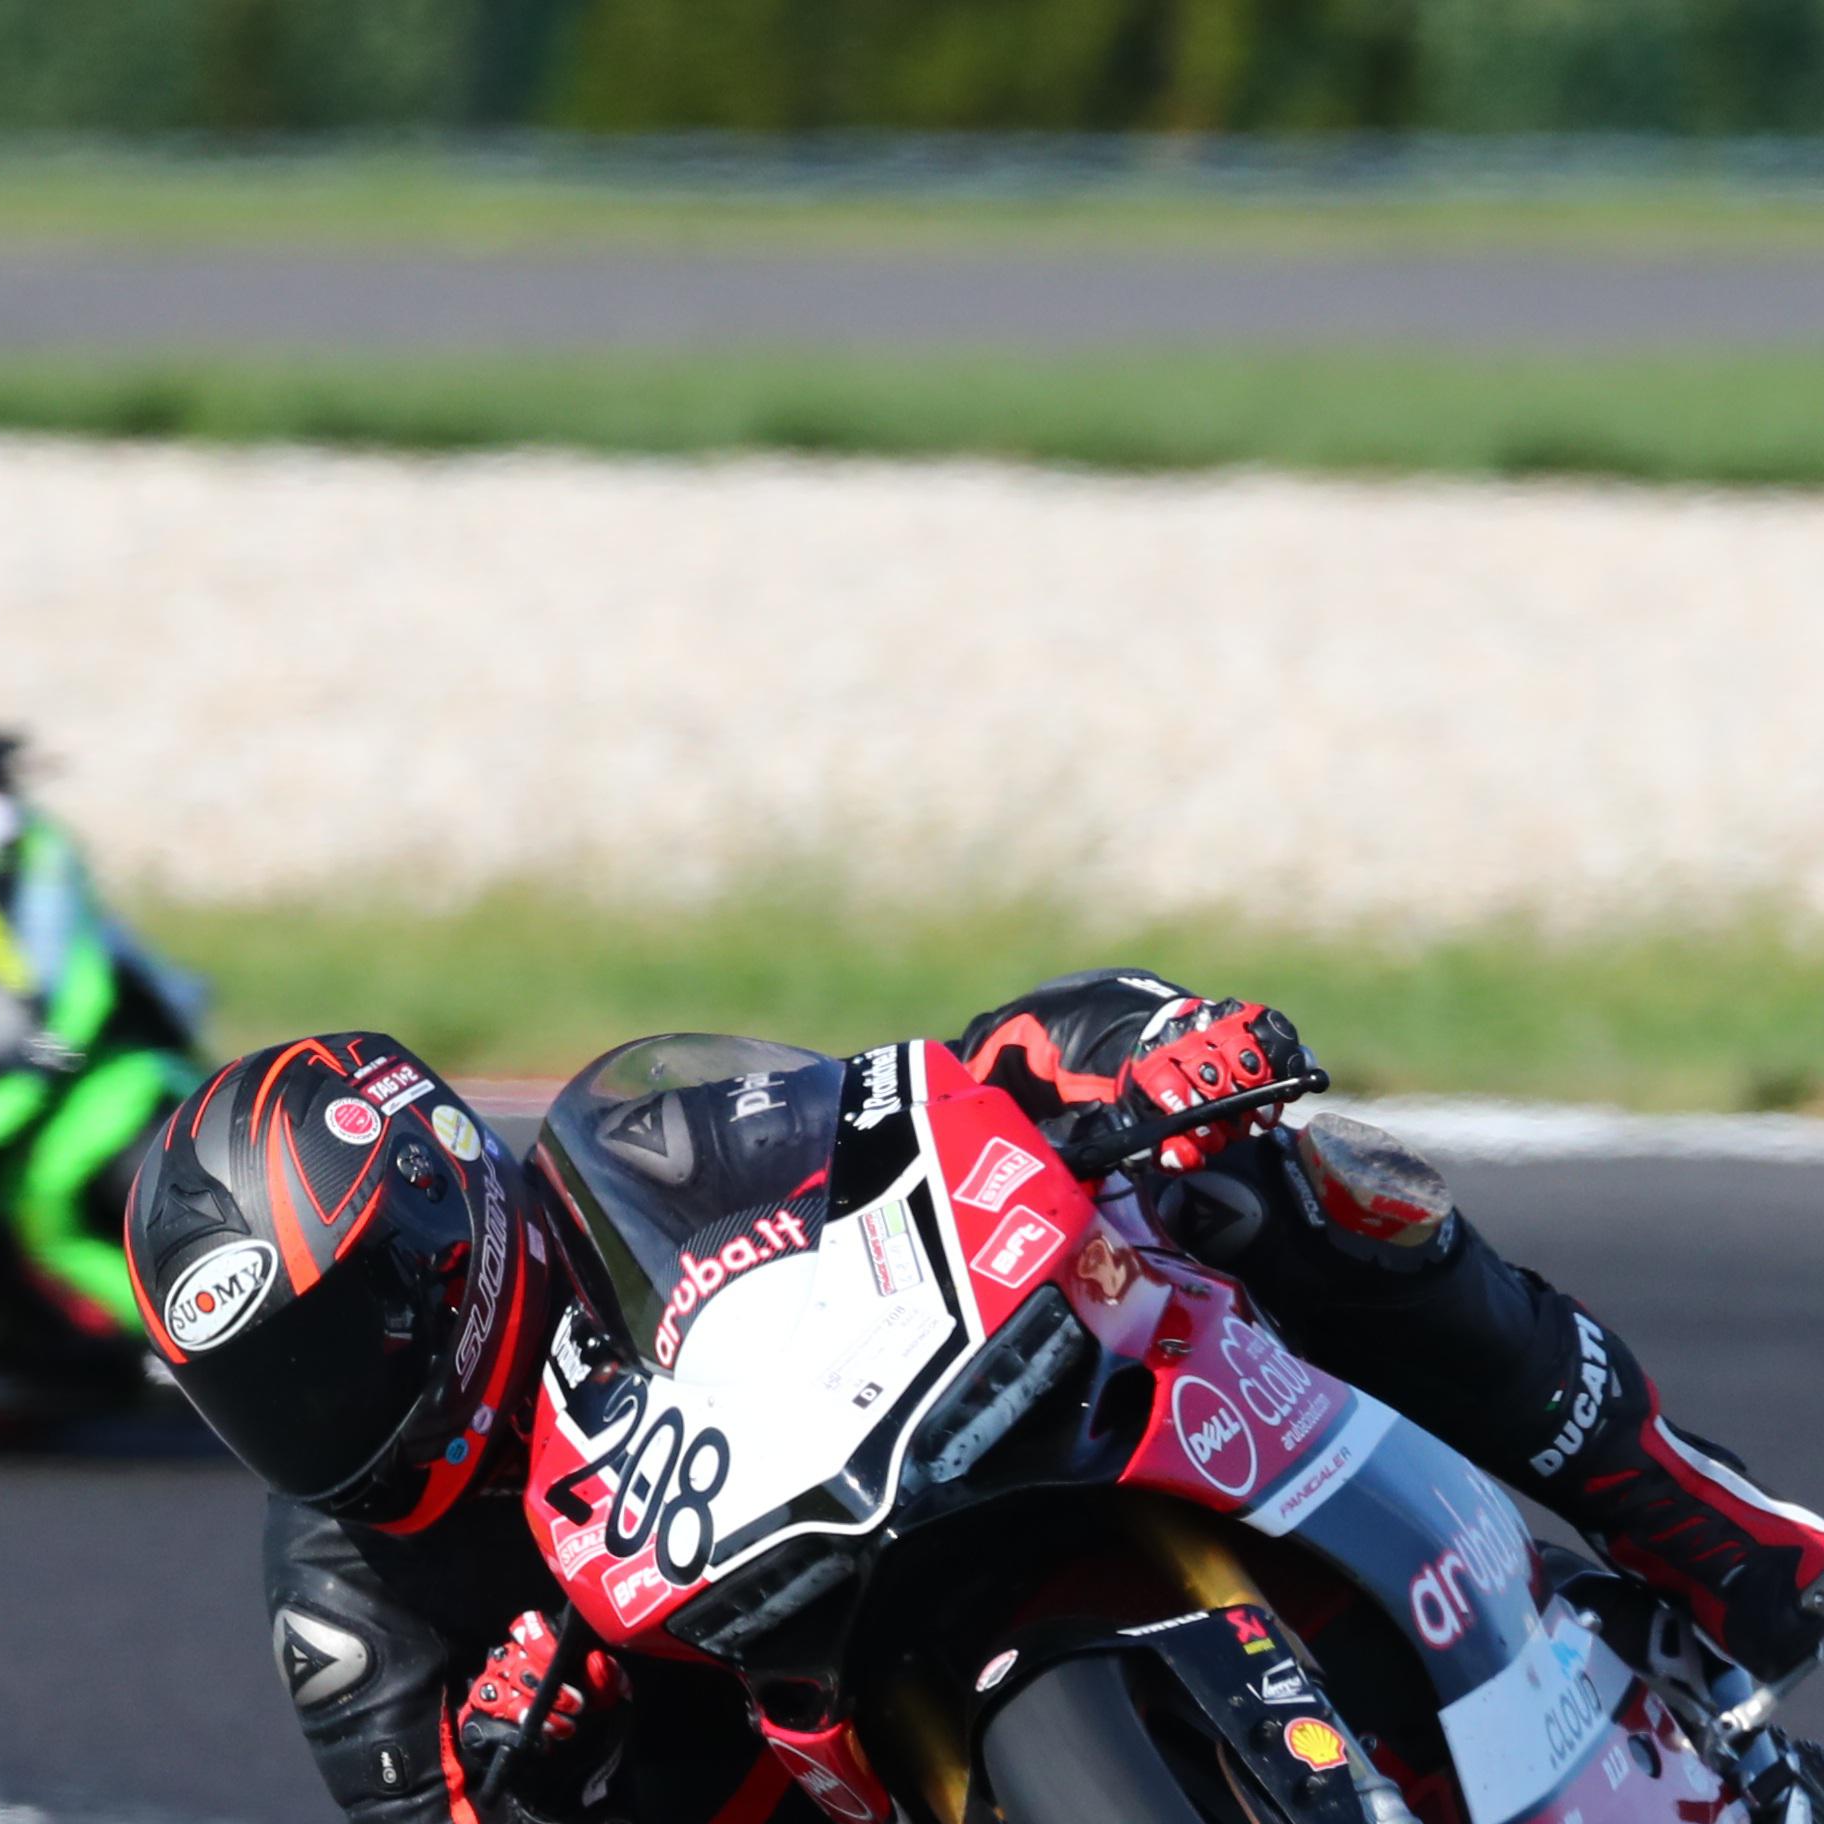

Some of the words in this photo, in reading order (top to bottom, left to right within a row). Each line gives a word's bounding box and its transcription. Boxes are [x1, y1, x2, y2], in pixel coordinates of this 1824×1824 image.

[367, 1077, 399, 1101] TAG
[981, 1153, 1029, 1202] STULZ
[169, 1261, 264, 1330] SUOMY
[654, 1209, 809, 1369] aruba.it
[1239, 1348, 1312, 1427] CLOUD
[1529, 1311, 1608, 1478] DUCATI
[1188, 1407, 1243, 1464] DELL
[545, 1374, 731, 1589] 208
